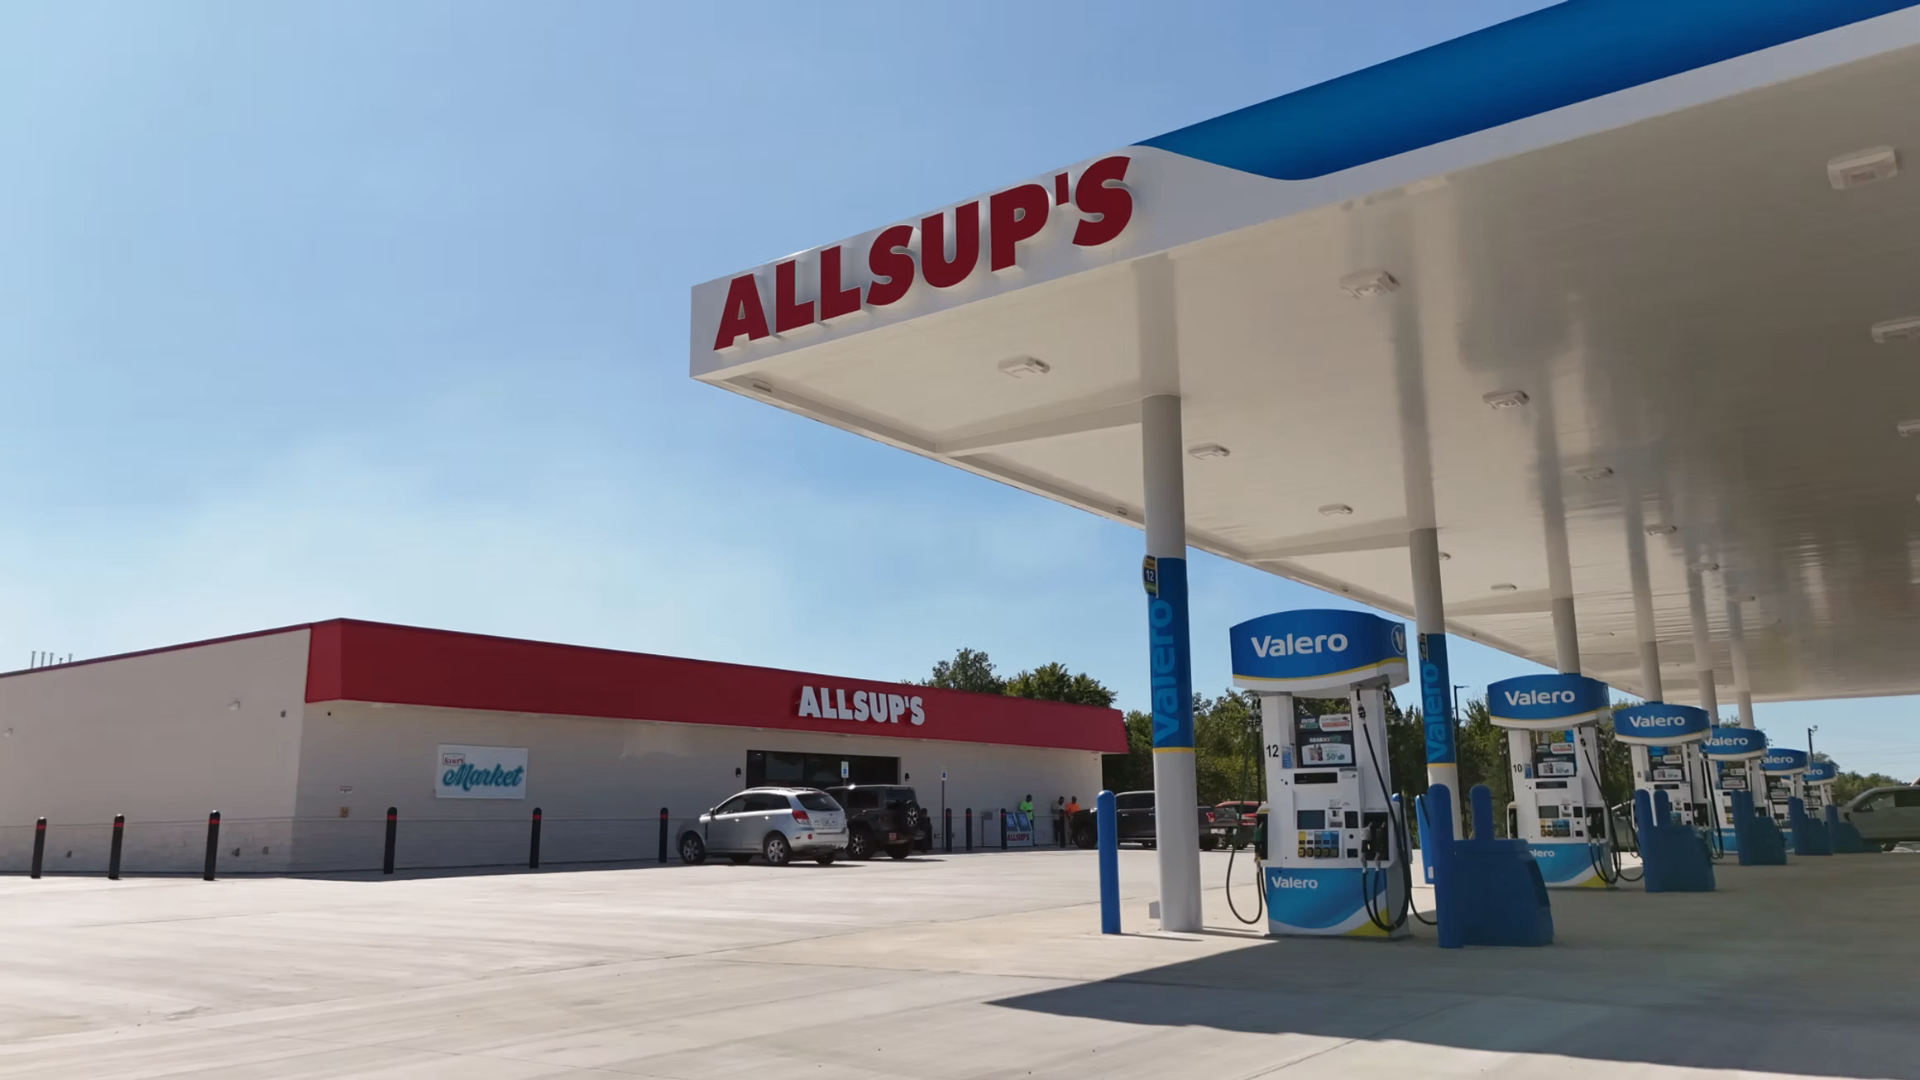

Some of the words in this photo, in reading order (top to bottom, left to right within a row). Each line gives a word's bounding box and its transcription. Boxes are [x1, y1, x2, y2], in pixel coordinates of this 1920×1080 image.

[713, 156, 1134, 351] ALLSUP'S
[1146, 570, 1155, 582] 12
[1251, 633, 1348, 658] Valero
[1150, 600, 1179, 745] Valero
[798, 686, 925, 725] ALLSUP'S
[1505, 690, 1576, 706] Valero
[1423, 663, 1448, 762] Valero
[1629, 715, 1686, 728] Valero
[1265, 744, 1279, 758] 12
[1763, 755, 1794, 764] alero
[1513, 763, 1523, 774] 10
[442, 763, 524, 792] Market
[1271, 876, 1318, 889] Valero
